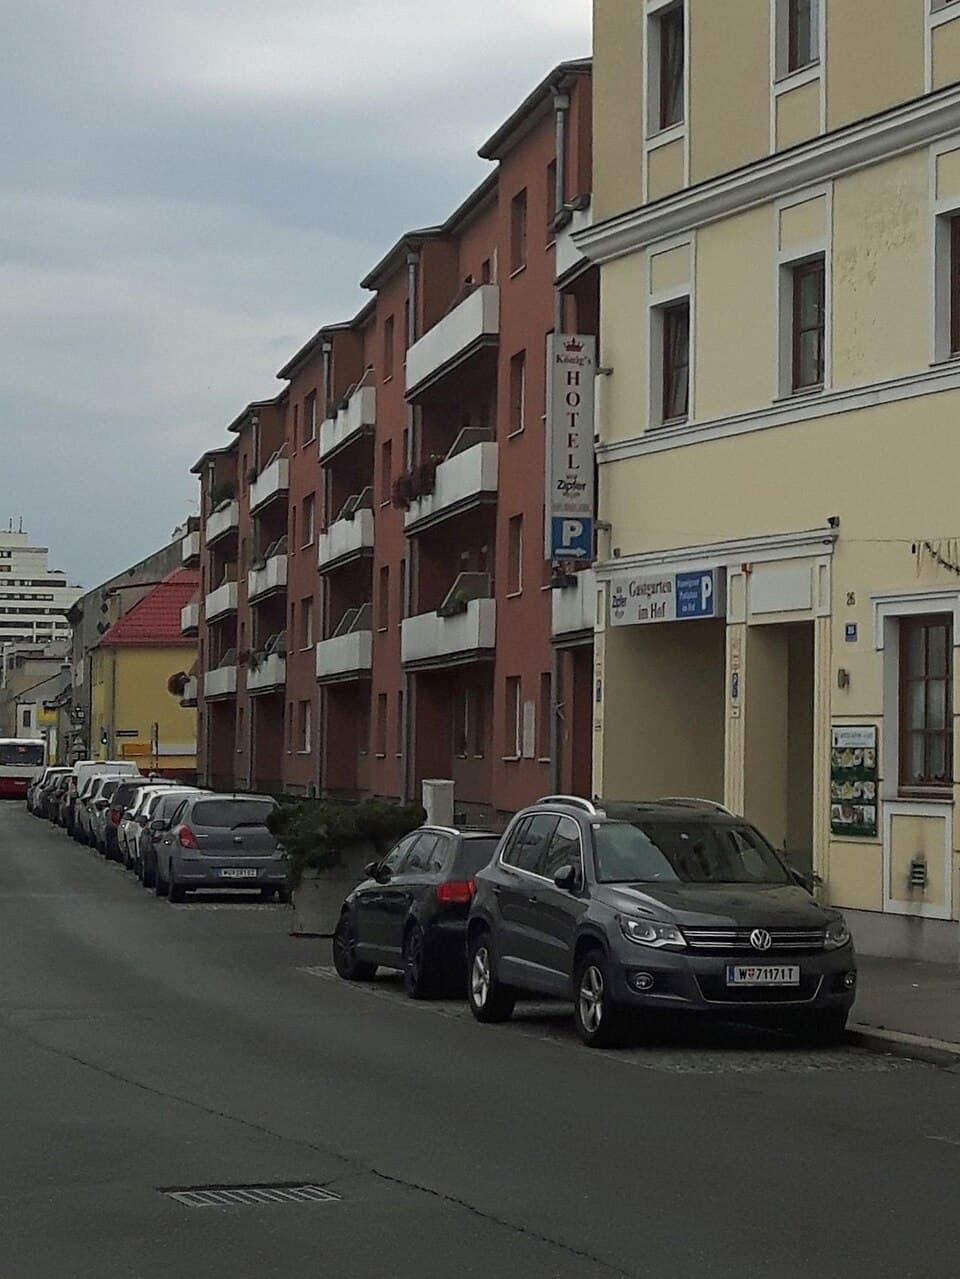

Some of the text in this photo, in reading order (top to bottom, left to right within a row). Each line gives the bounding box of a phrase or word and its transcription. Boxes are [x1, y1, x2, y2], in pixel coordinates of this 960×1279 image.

[565, 370, 581, 470] HOTEL
[562, 520, 584, 546] P
[701, 575, 712, 611] P
